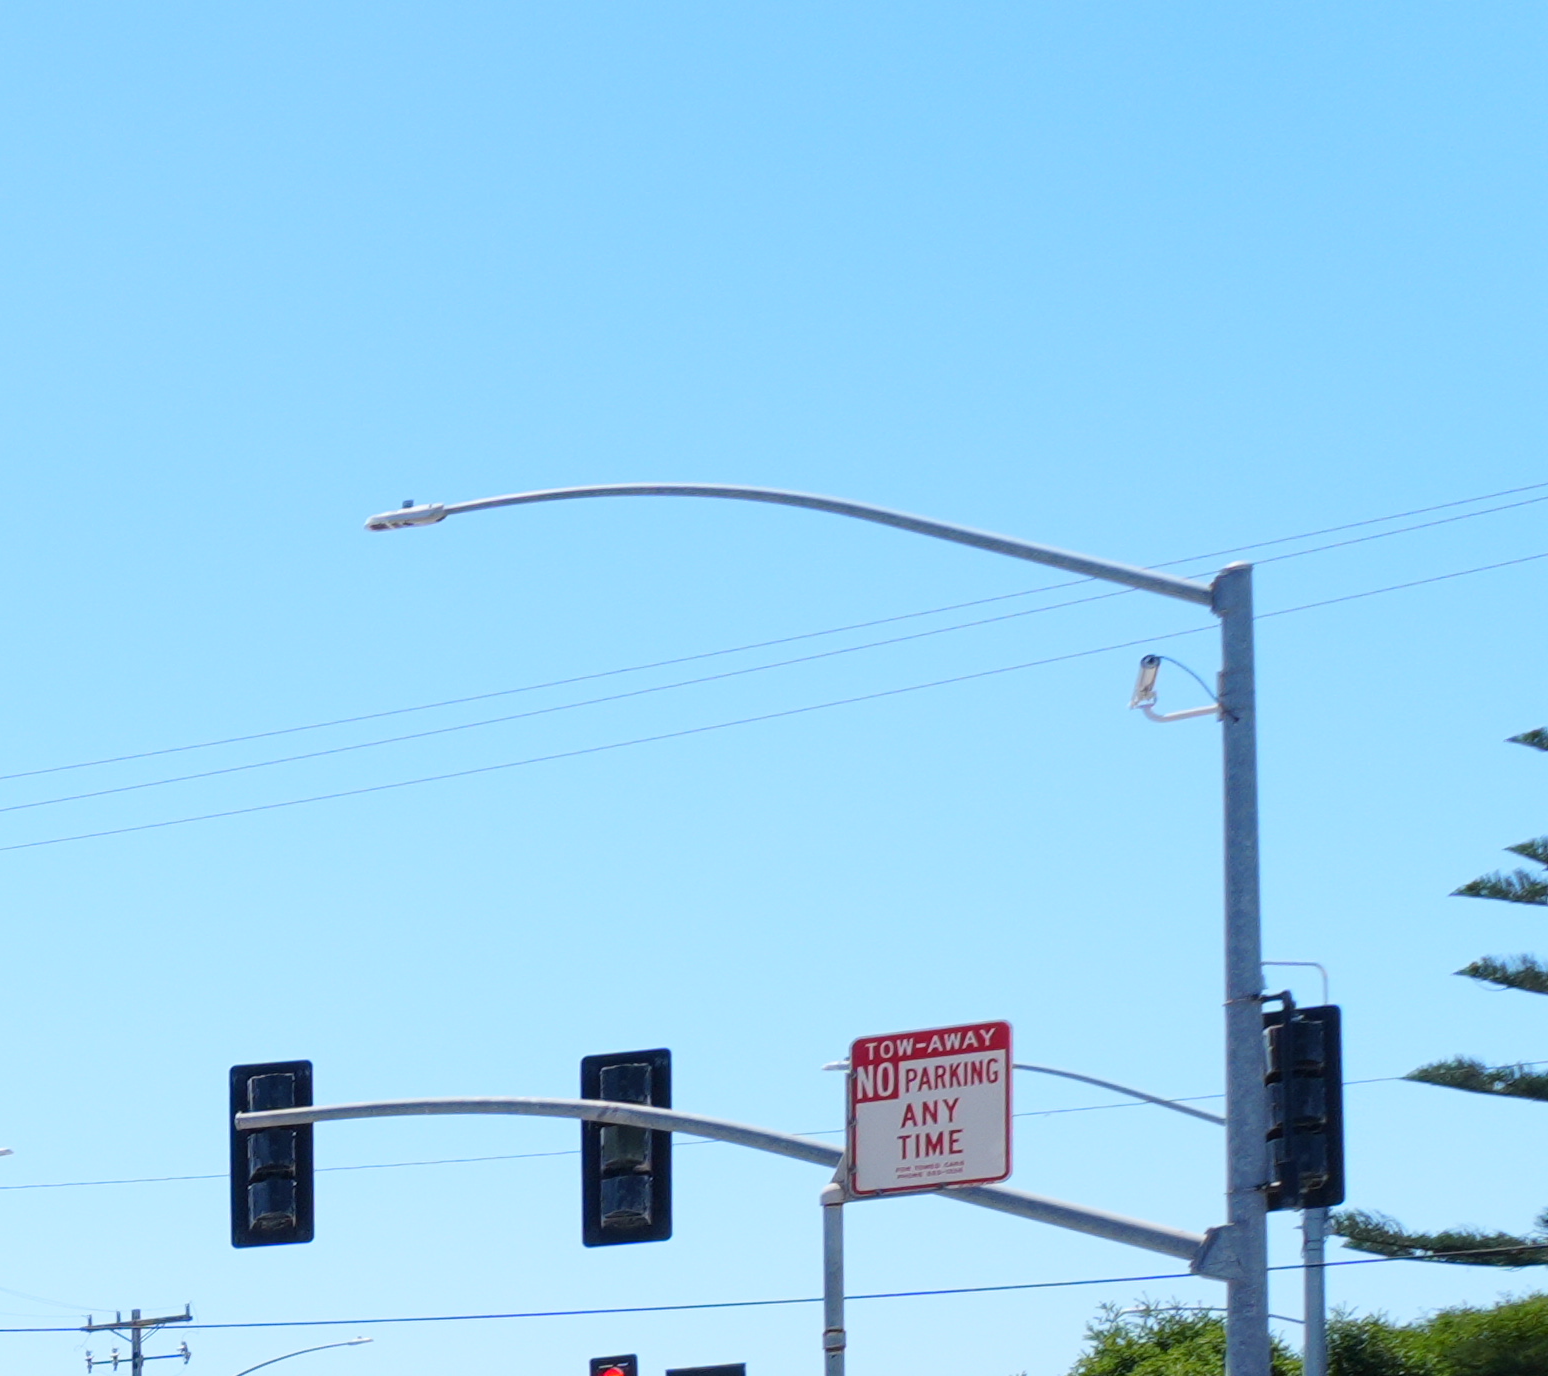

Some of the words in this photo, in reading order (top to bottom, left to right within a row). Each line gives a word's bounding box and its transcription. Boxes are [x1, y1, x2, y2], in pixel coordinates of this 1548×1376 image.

[865, 1027, 997, 1061] TOW-AWAY
[856, 1061, 896, 1100] NO
[905, 1057, 999, 1094] PARKING
[900, 1097, 961, 1130] ANY
[896, 1129, 964, 1160] TIME
